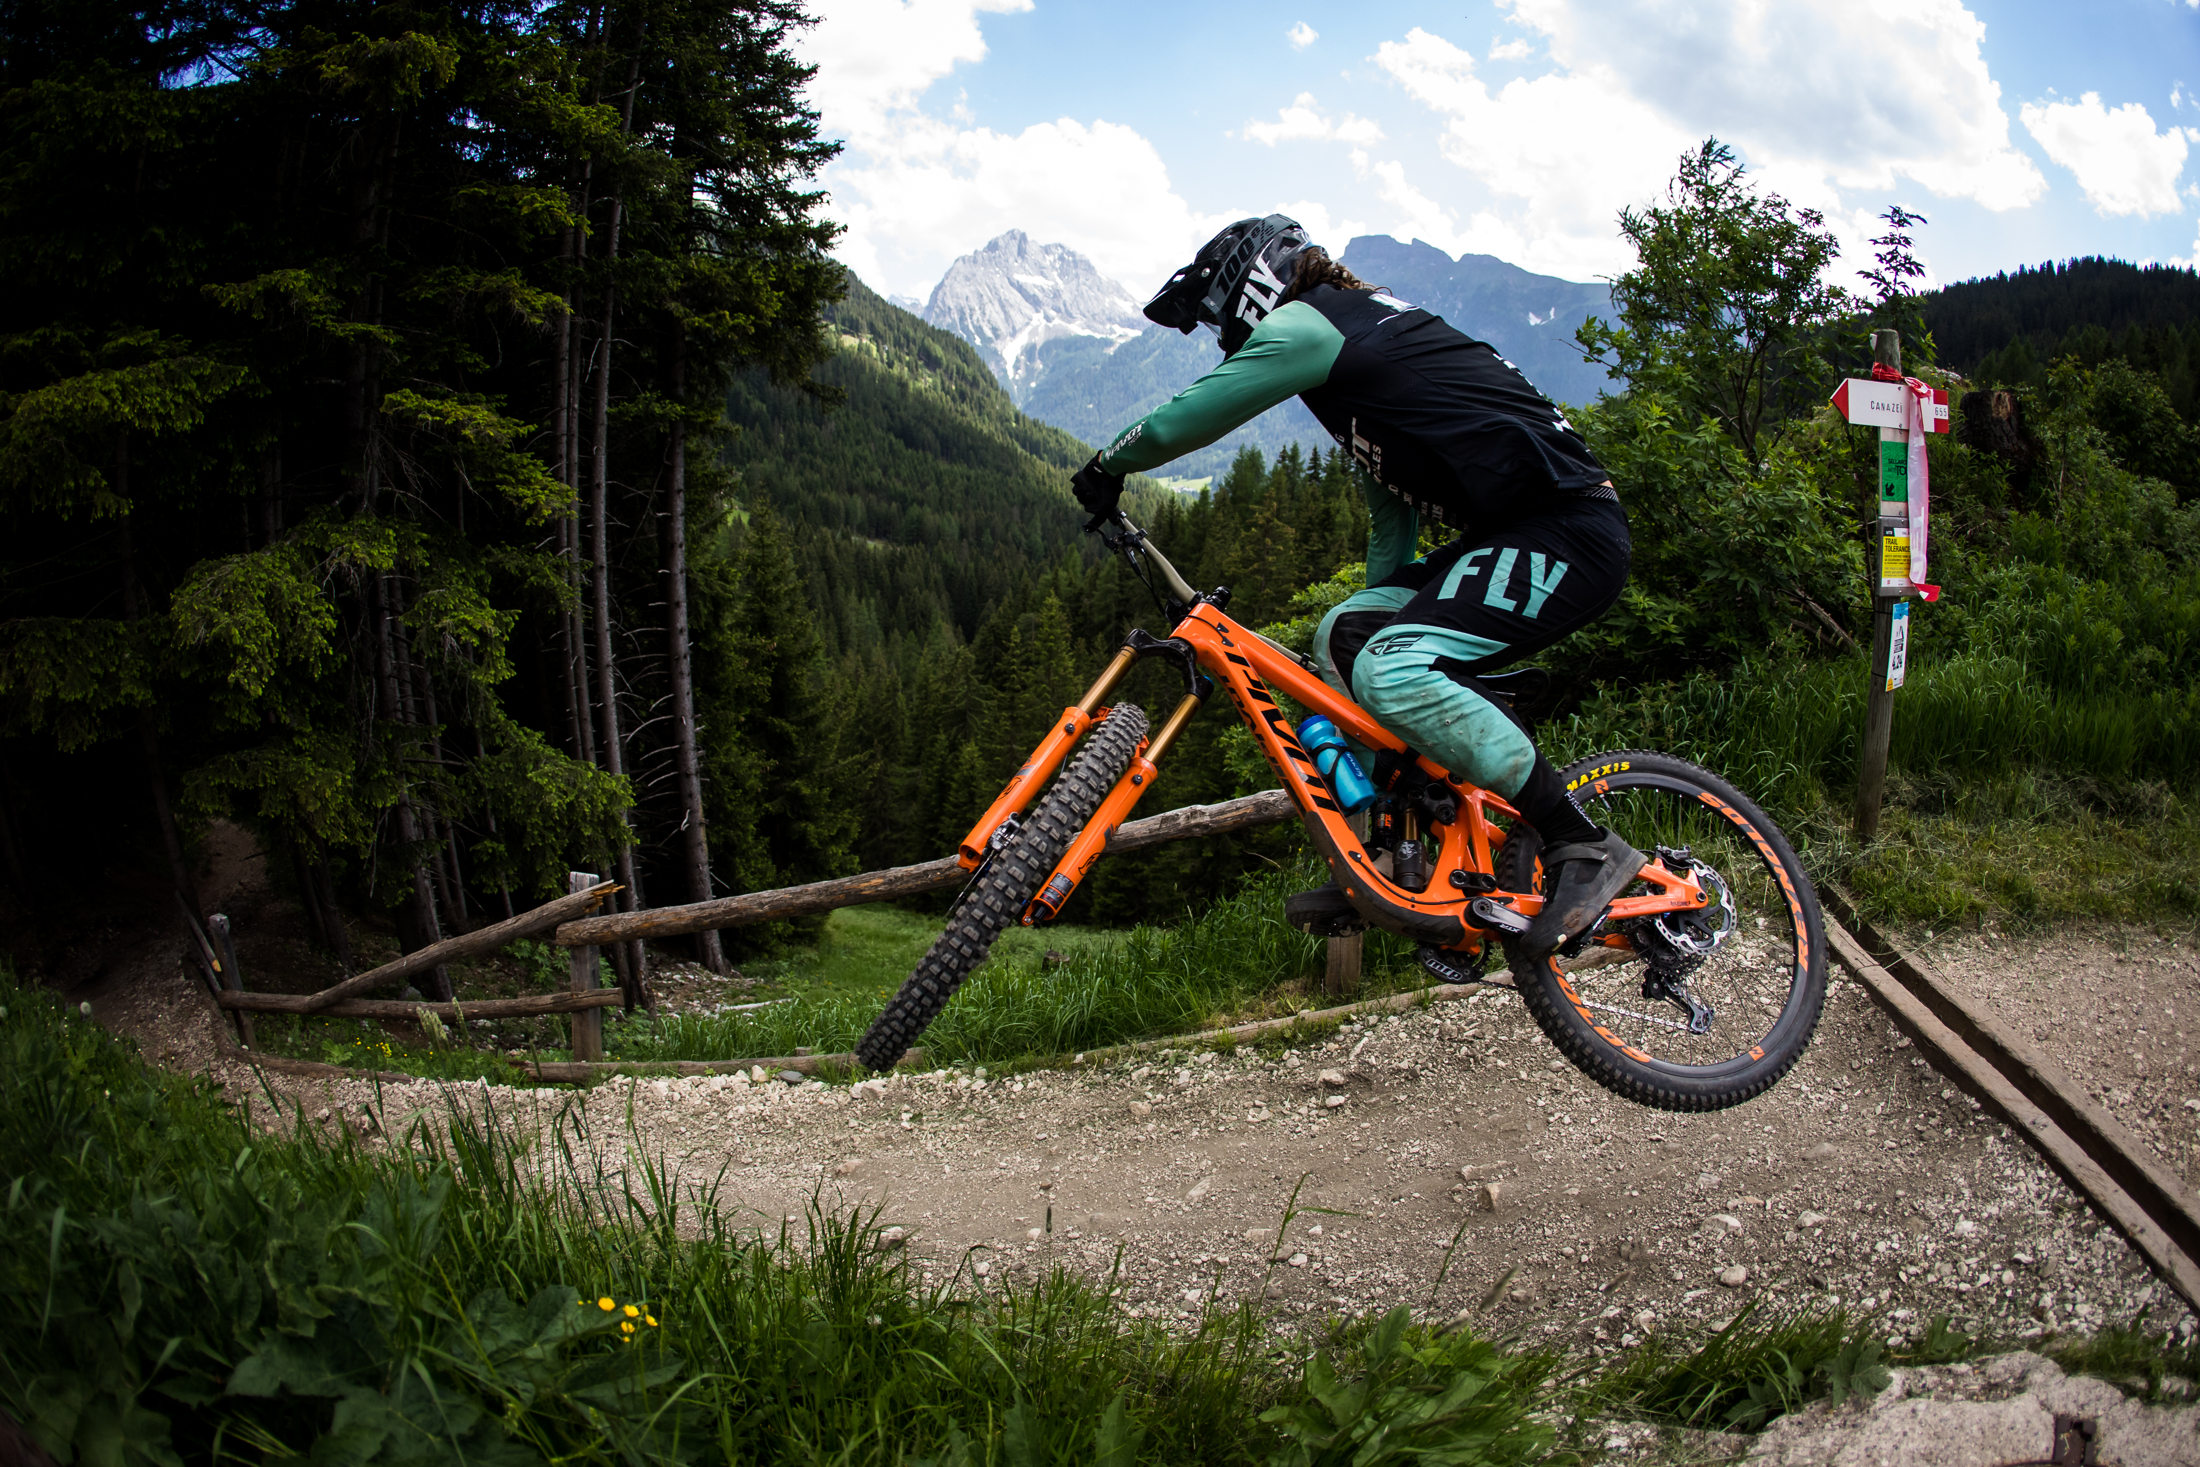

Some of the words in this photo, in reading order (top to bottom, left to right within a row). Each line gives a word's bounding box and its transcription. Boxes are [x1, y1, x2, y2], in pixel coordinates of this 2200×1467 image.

[1216, 220, 1275, 295] 100%
[1235, 239, 1286, 329] FLY
[1935, 407, 1947, 417] 655
[1111, 420, 1147, 457] PIVOT
[1895, 465, 1907, 476] TO
[1885, 545, 1910, 553] TOLERANCE
[1437, 547, 1570, 619] FLY
[1567, 761, 1630, 791] MAXXIS
[1697, 792, 1808, 972] REYNOLDS
[1426, 959, 1463, 981] mrp
